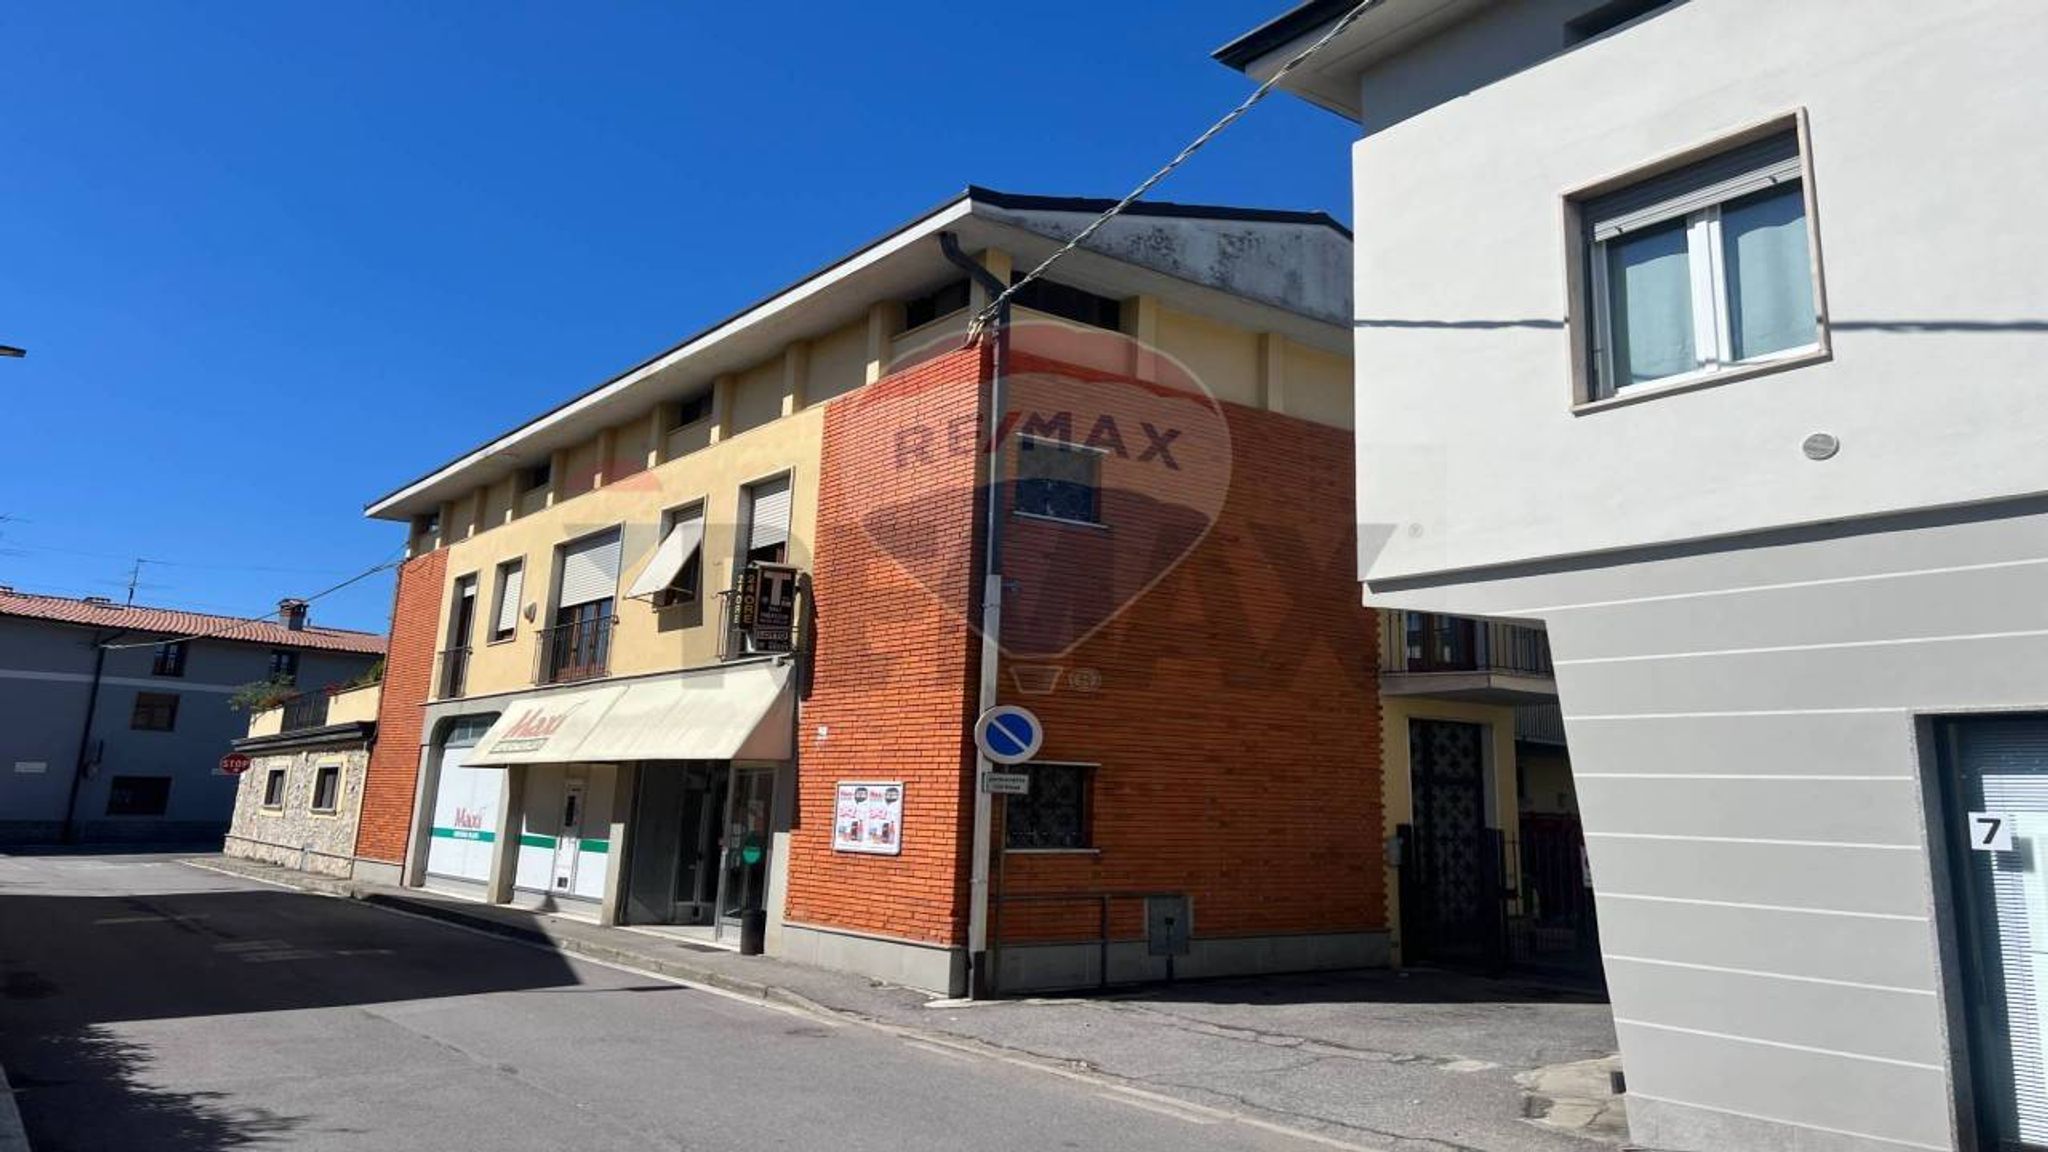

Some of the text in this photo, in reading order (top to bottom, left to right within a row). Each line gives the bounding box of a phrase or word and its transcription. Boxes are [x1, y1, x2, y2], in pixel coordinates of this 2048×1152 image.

[763, 570, 792, 606] T
[223, 759, 249, 768] STOP
[1977, 818, 2001, 844] 7
